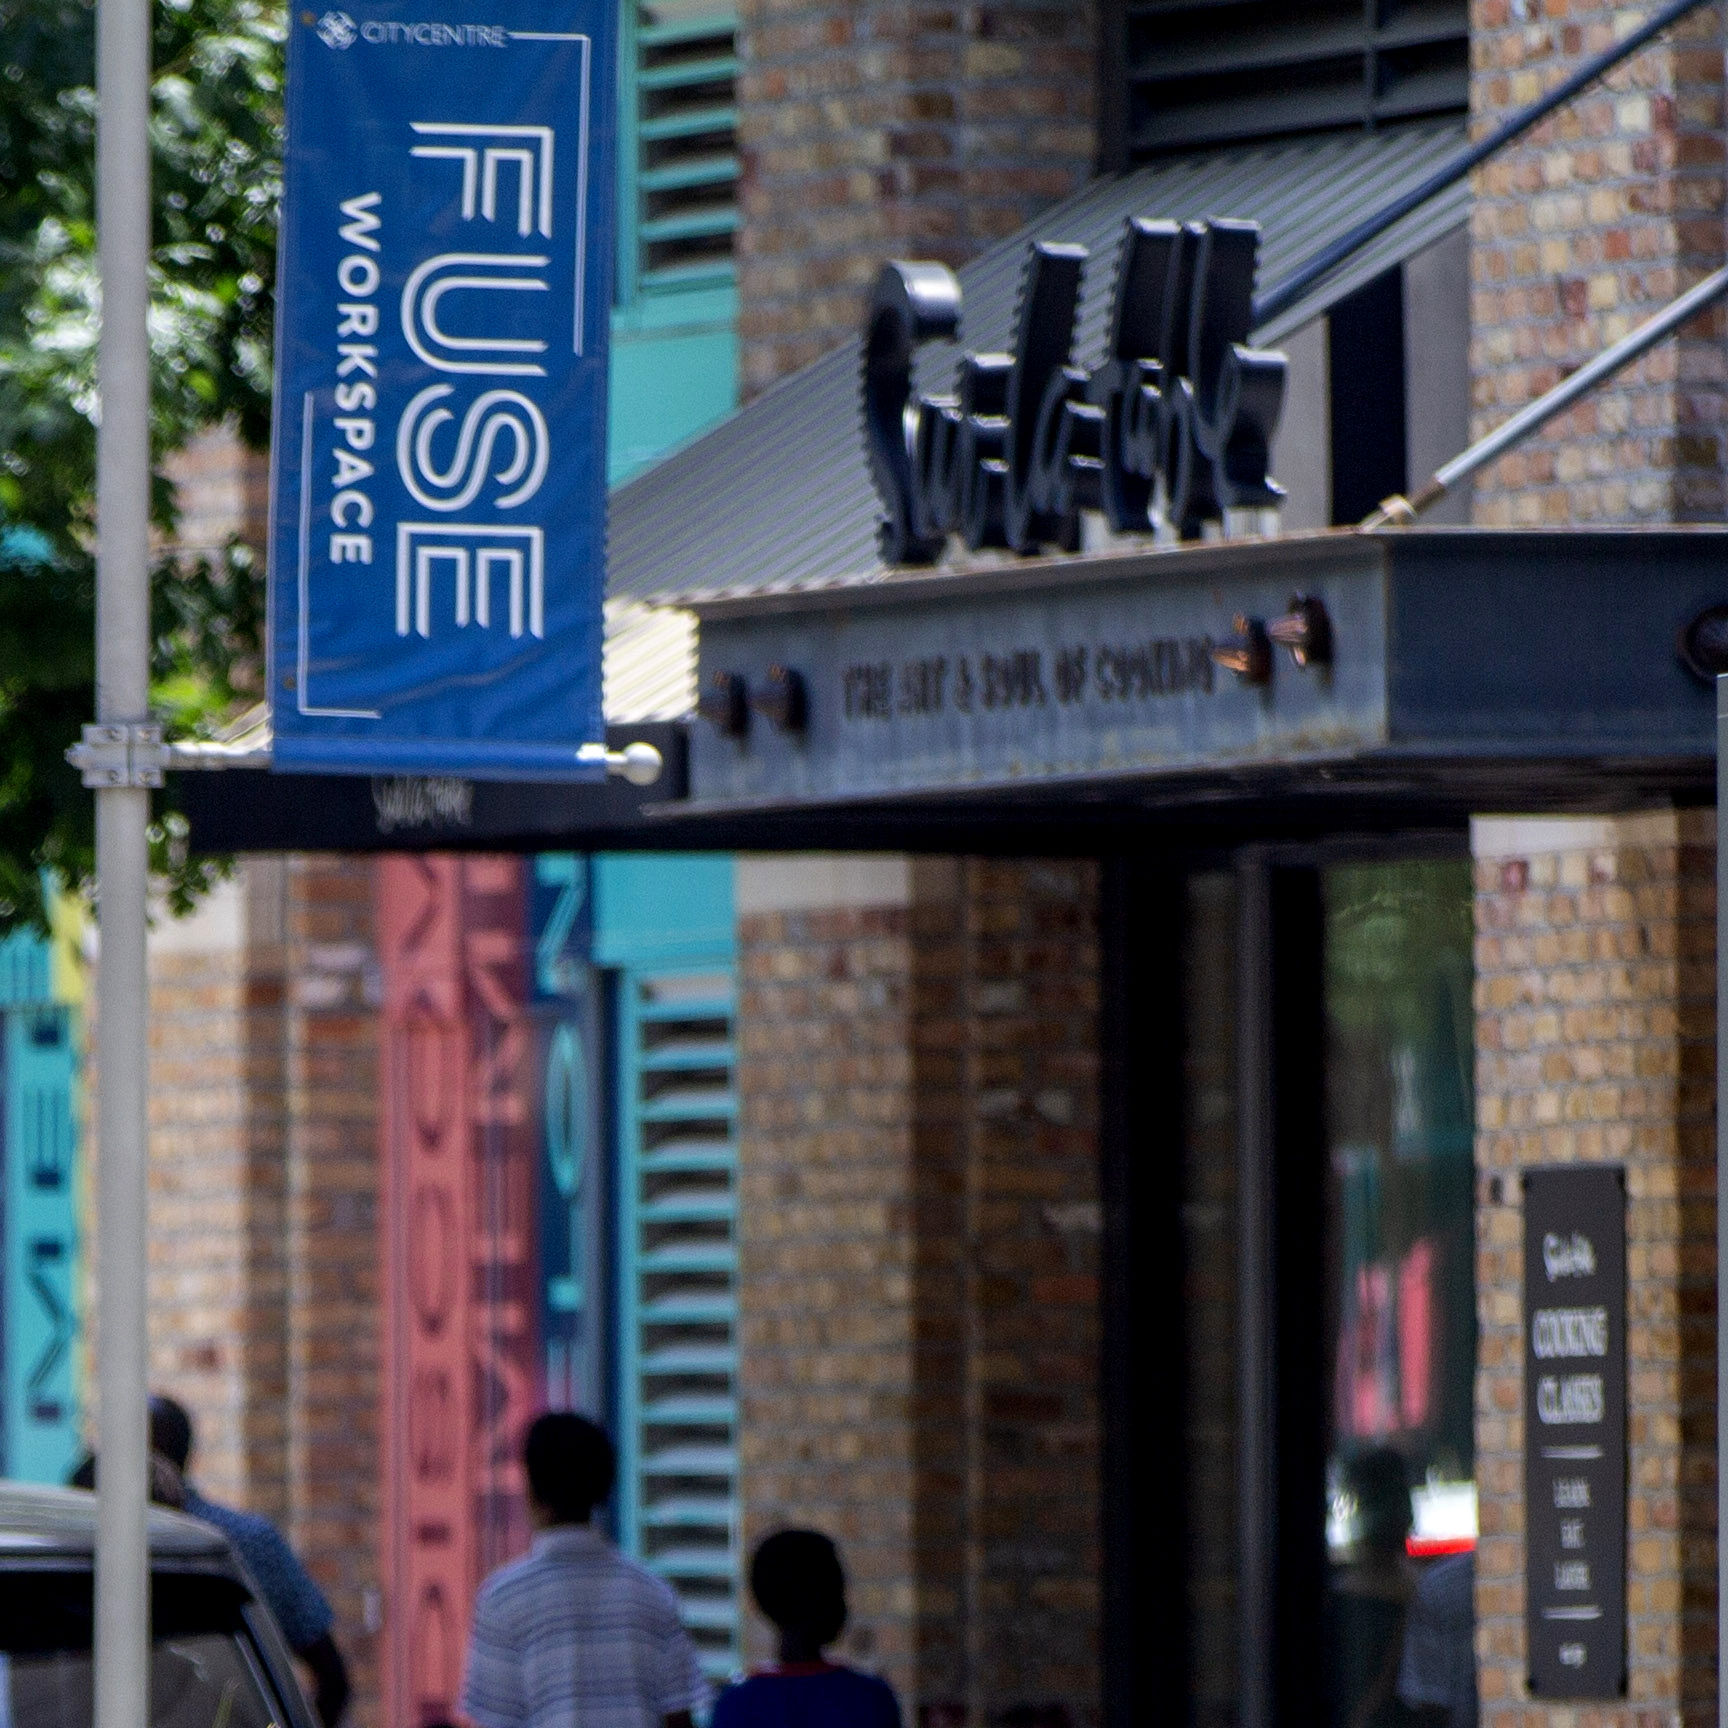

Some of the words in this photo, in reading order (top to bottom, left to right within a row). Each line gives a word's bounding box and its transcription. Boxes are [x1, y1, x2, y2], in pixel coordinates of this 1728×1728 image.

[359, 20, 509, 48] CITYCENTRE
[328, 190, 383, 566] WORKSPACE
[395, 121, 555, 640] FUSE
